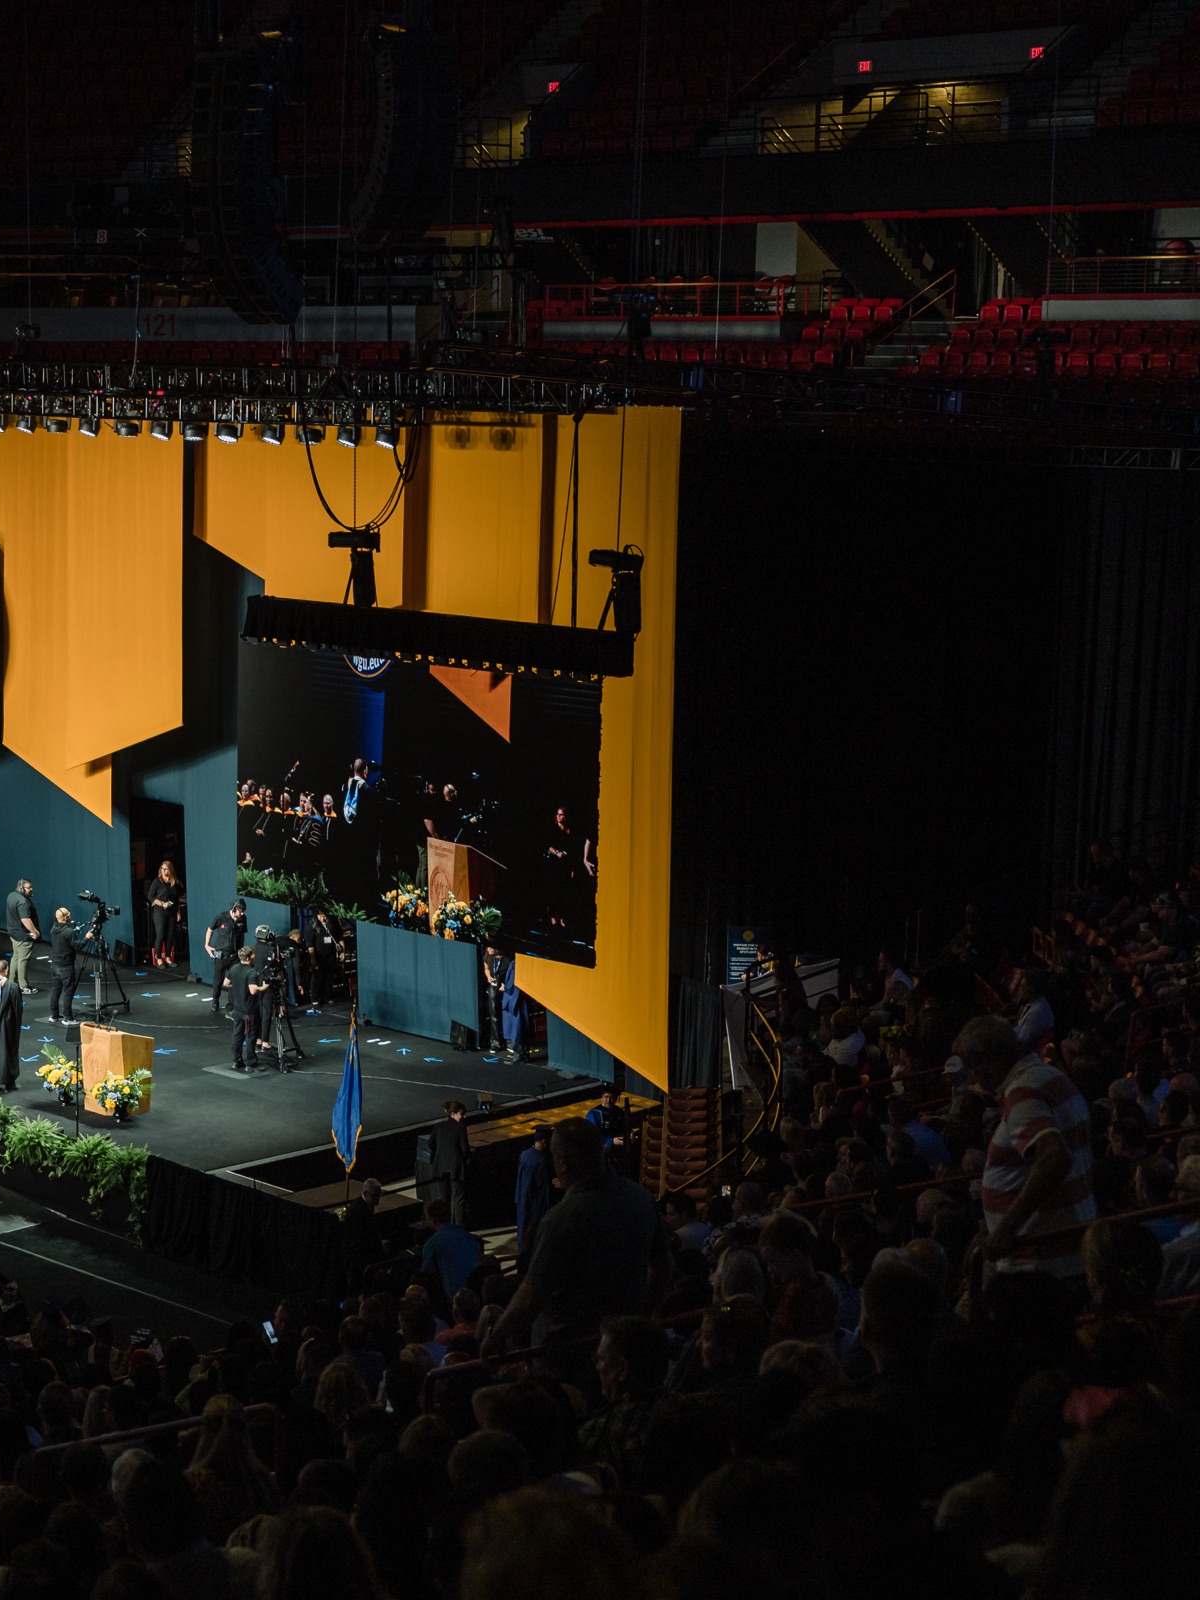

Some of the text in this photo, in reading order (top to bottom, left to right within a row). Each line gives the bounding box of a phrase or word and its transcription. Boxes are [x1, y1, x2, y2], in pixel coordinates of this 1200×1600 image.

[859, 60, 871, 73] EXIT
[99, 231, 106, 243] 8
[143, 313, 176, 337] 121
